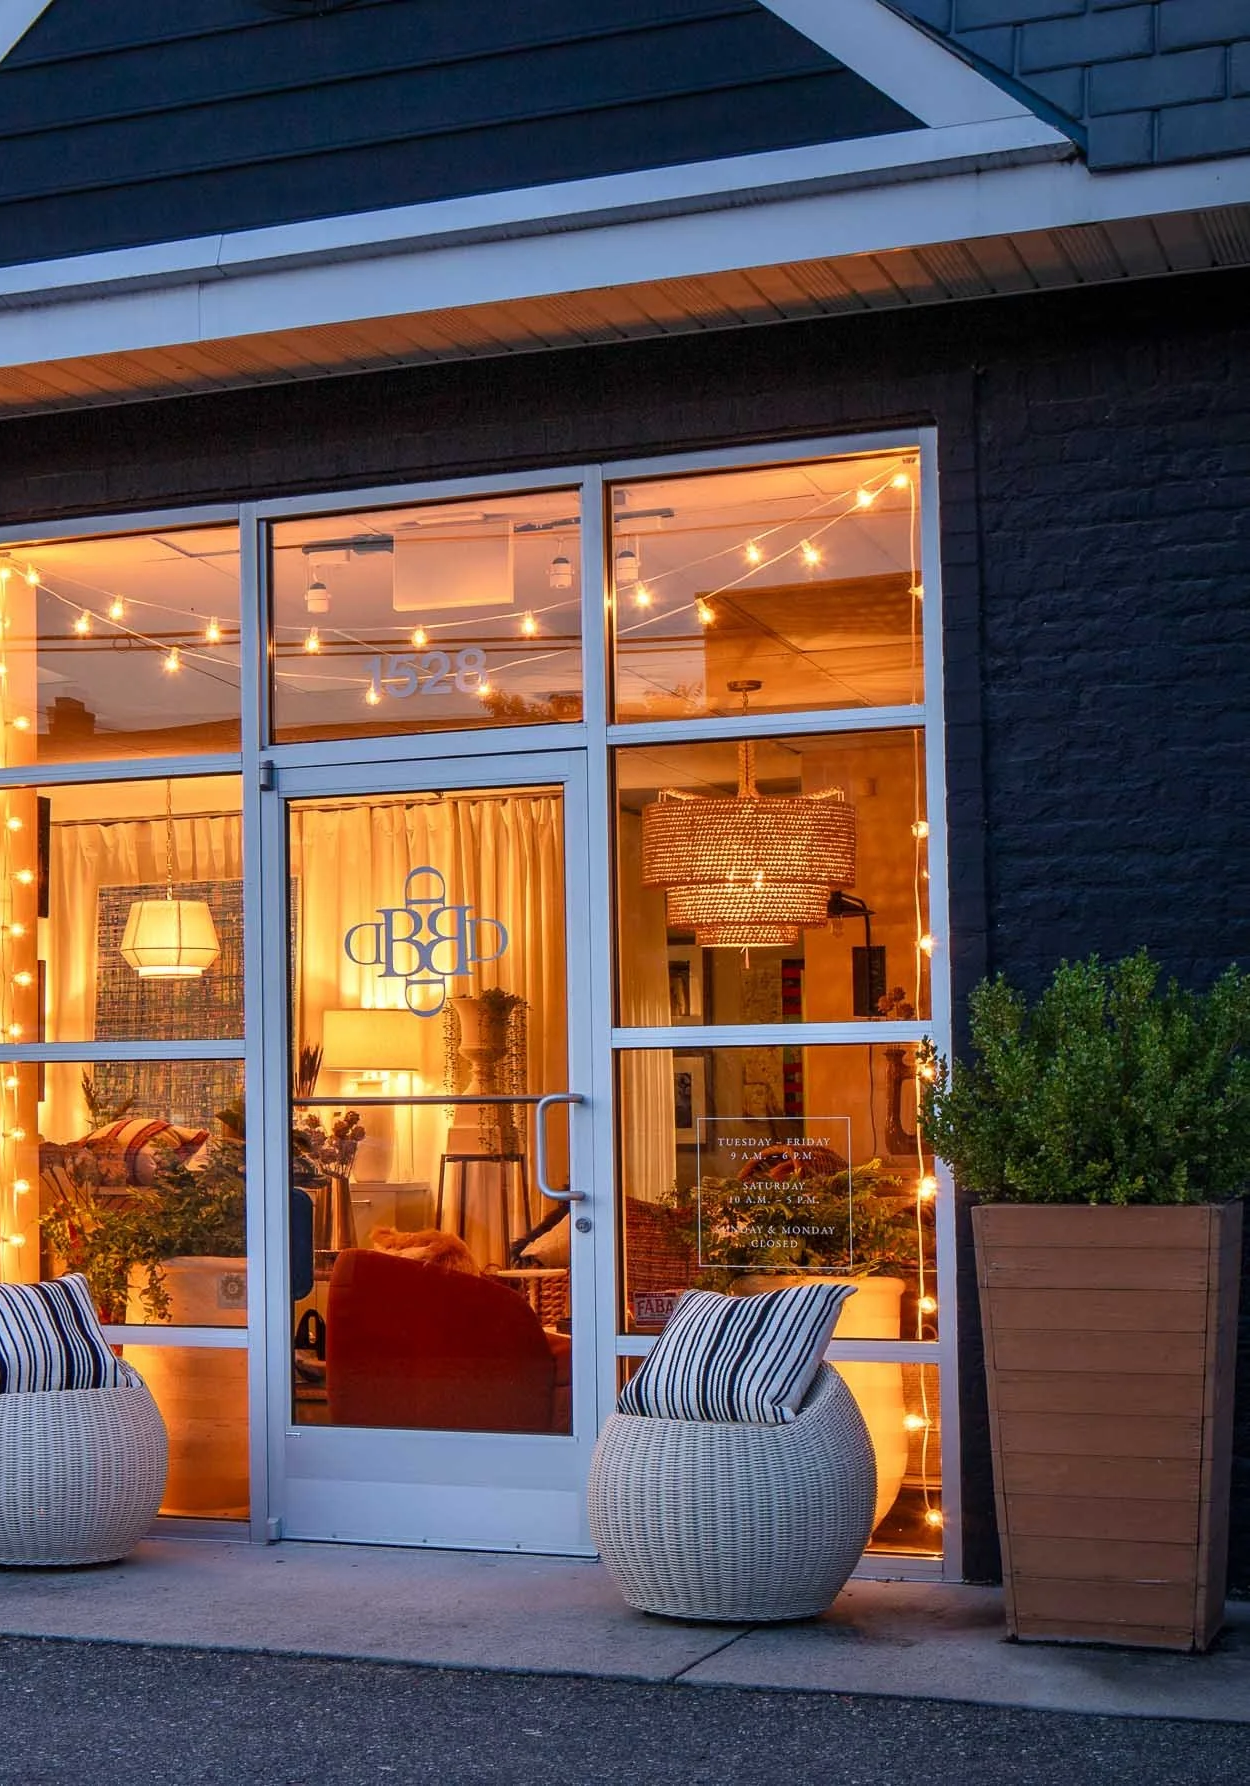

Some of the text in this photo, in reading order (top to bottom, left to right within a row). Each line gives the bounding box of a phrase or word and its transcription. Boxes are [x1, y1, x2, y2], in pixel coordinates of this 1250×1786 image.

[362, 647, 487, 698] 1528
[717, 1137, 772, 1147] TUESDAY
[786, 1137, 831, 1147] FRIDAY
[730, 1151, 737, 1160] 9
[741, 1151, 767, 1160] A.M.
[781, 1151, 789, 1160] 6
[793, 1151, 817, 1160] P.M.
[742, 1181, 806, 1191] SATURDAY
[728, 1195, 741, 1205] 10
[745, 1195, 771, 1205] A.M.
[786, 1195, 792, 1205] 5
[797, 1195, 820, 1205] P.M.
[713, 1225, 836, 1236] NDAY & MONDAY
[750, 1239, 799, 1249] CLOSED
